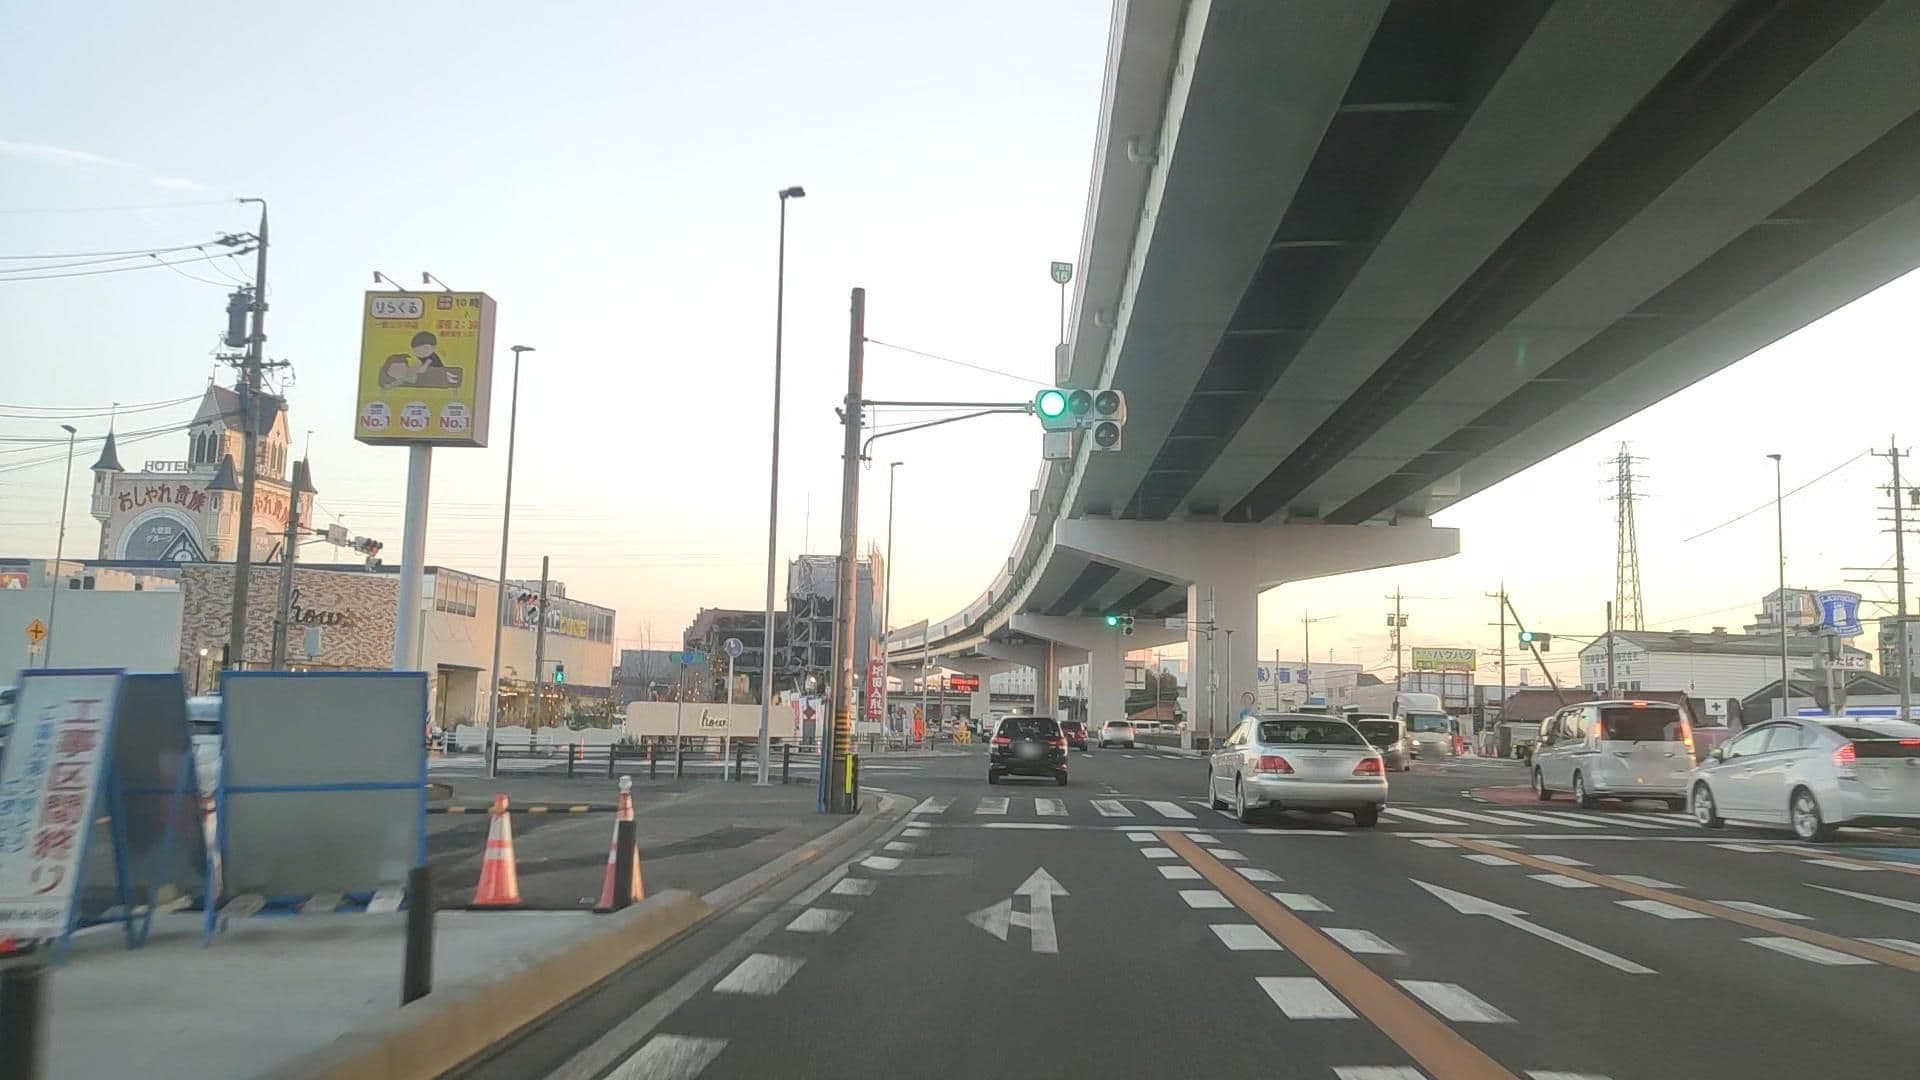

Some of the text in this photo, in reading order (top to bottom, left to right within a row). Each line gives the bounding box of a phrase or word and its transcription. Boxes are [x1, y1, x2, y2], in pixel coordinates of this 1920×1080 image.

[376, 301, 418, 313] りらくる
[360, 415, 390, 428] No.1
[400, 415, 430, 428] No.1
[439, 416, 470, 429] No.1
[145, 461, 188, 472] HOTEL
[118, 484, 208, 513] おしゃれ貴族
